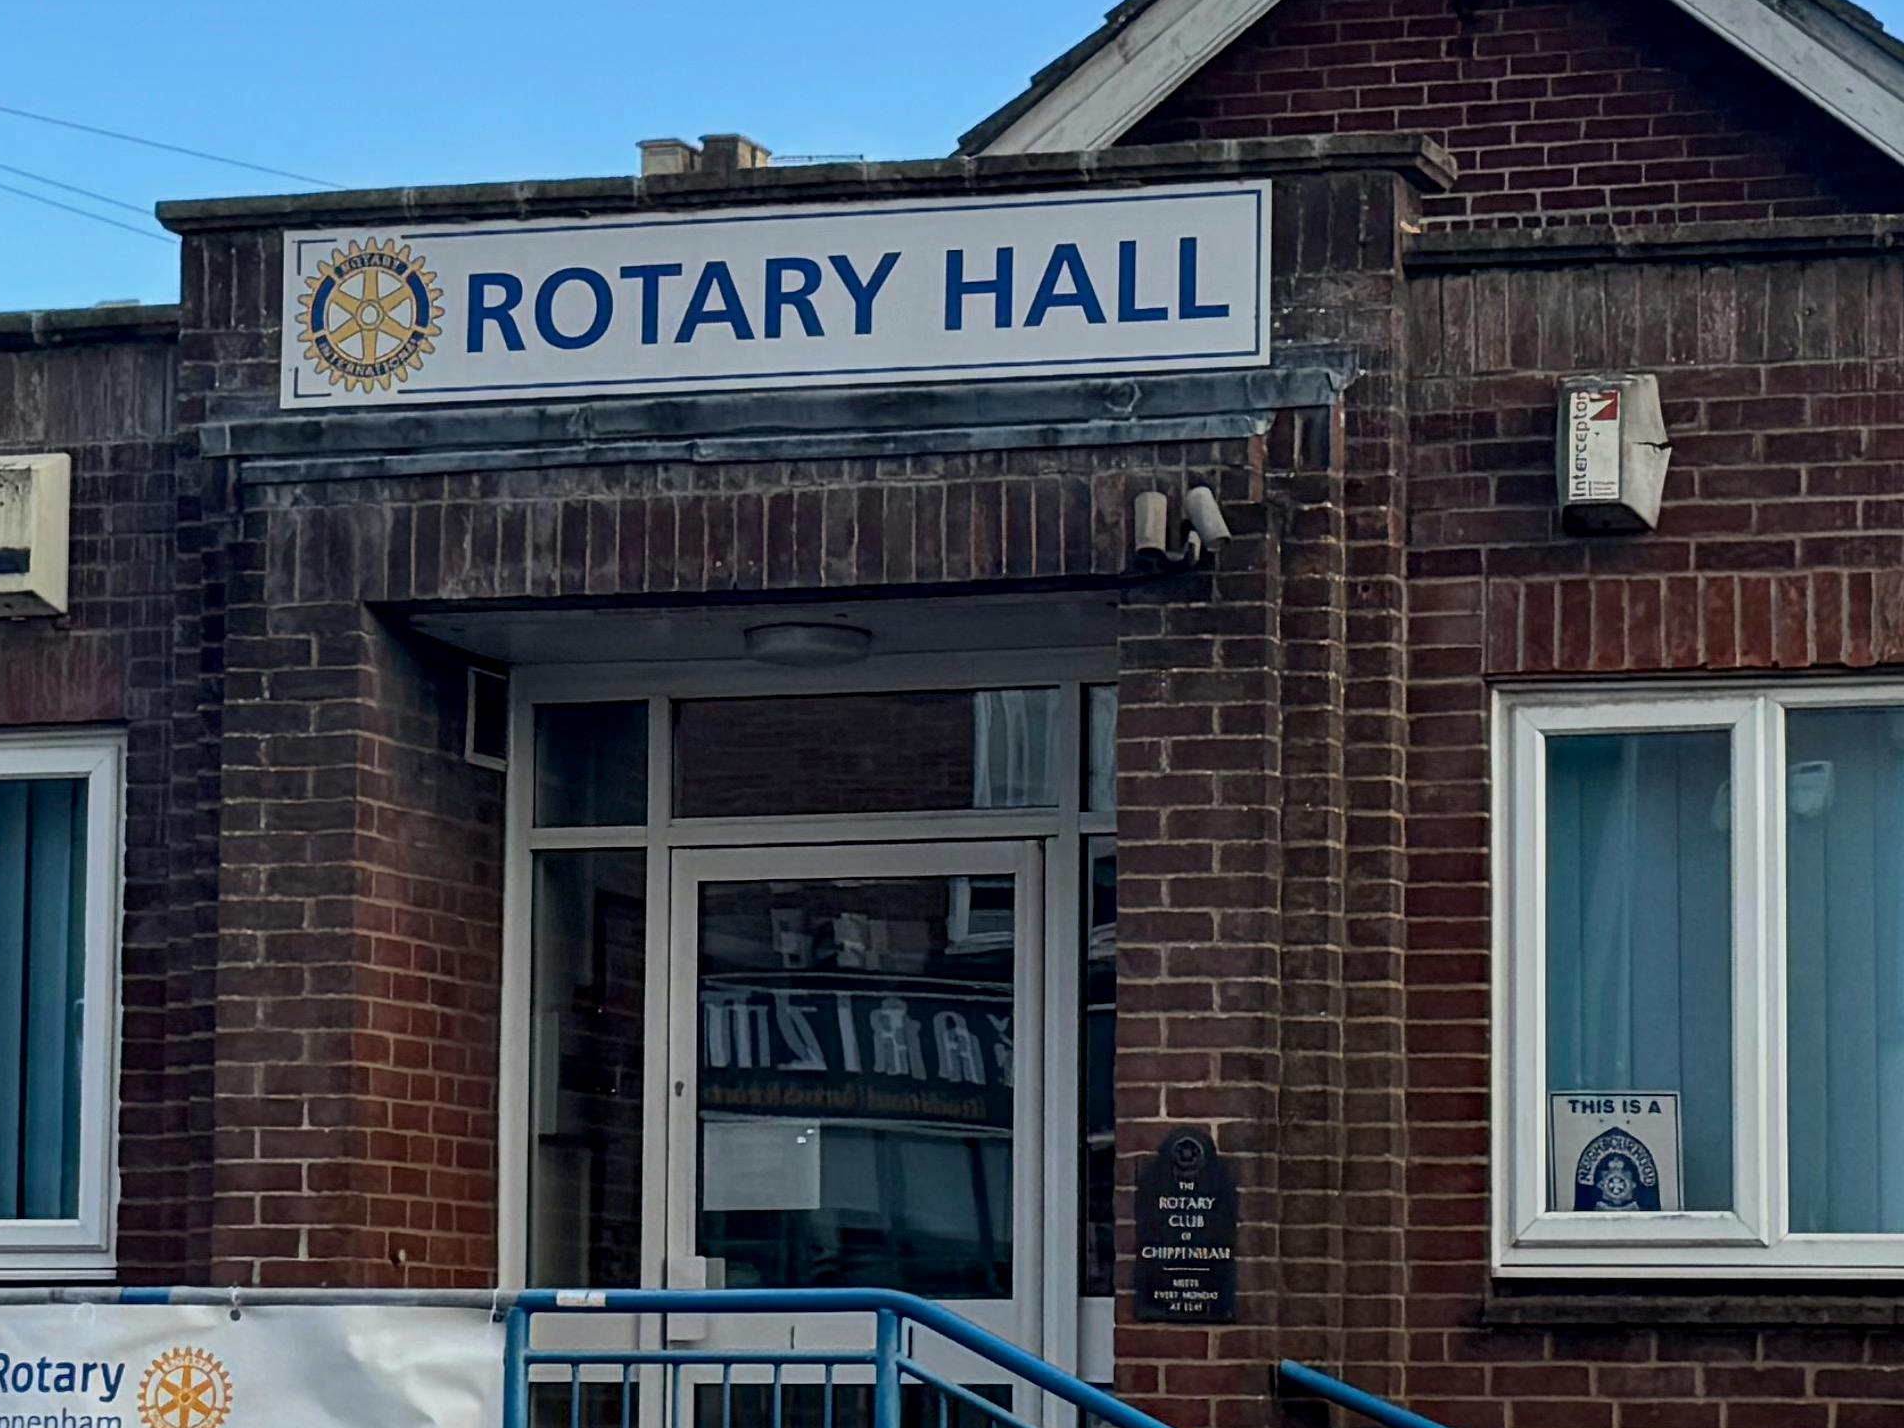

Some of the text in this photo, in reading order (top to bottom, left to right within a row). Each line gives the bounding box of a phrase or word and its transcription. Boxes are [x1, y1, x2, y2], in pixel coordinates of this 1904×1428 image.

[465, 235, 1230, 354] ROTARY HALL
[1568, 1099, 1662, 1114] THIS IS A
[1159, 1197, 1215, 1210] ROTARY
[1168, 1215, 1205, 1228] CLUB
[1142, 1246, 1231, 1260] CHIPPENHAM
